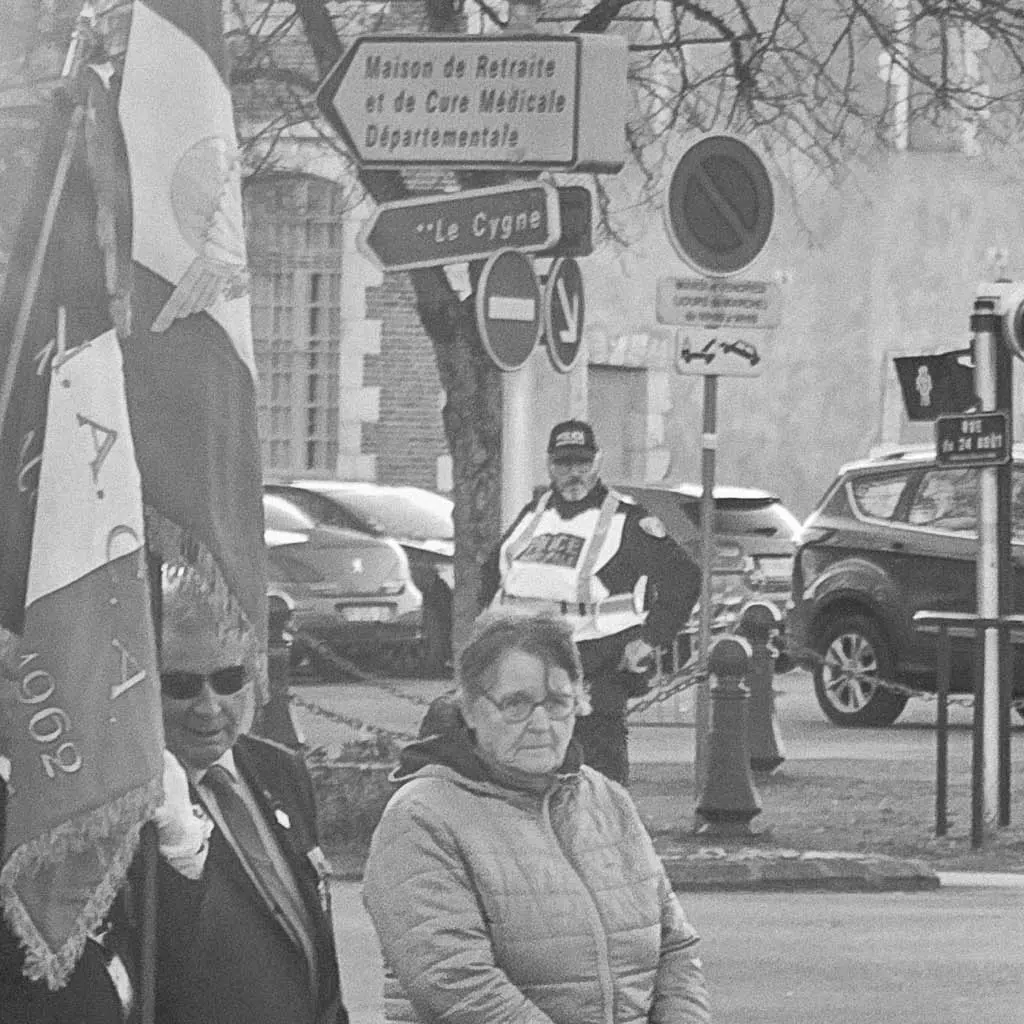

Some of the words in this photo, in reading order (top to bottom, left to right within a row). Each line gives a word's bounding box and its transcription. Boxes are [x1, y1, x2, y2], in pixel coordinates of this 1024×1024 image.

[365, 55, 434, 79] Maison
[443, 56, 466, 78] de
[475, 54, 556, 79] Retraite
[365, 93, 385, 113] et
[394, 90, 417, 113] de
[425, 89, 470, 113] Cure
[479, 88, 567, 113] Médicale
[365, 123, 519, 151] Départementale
[472, 210, 541, 241] Cygne
